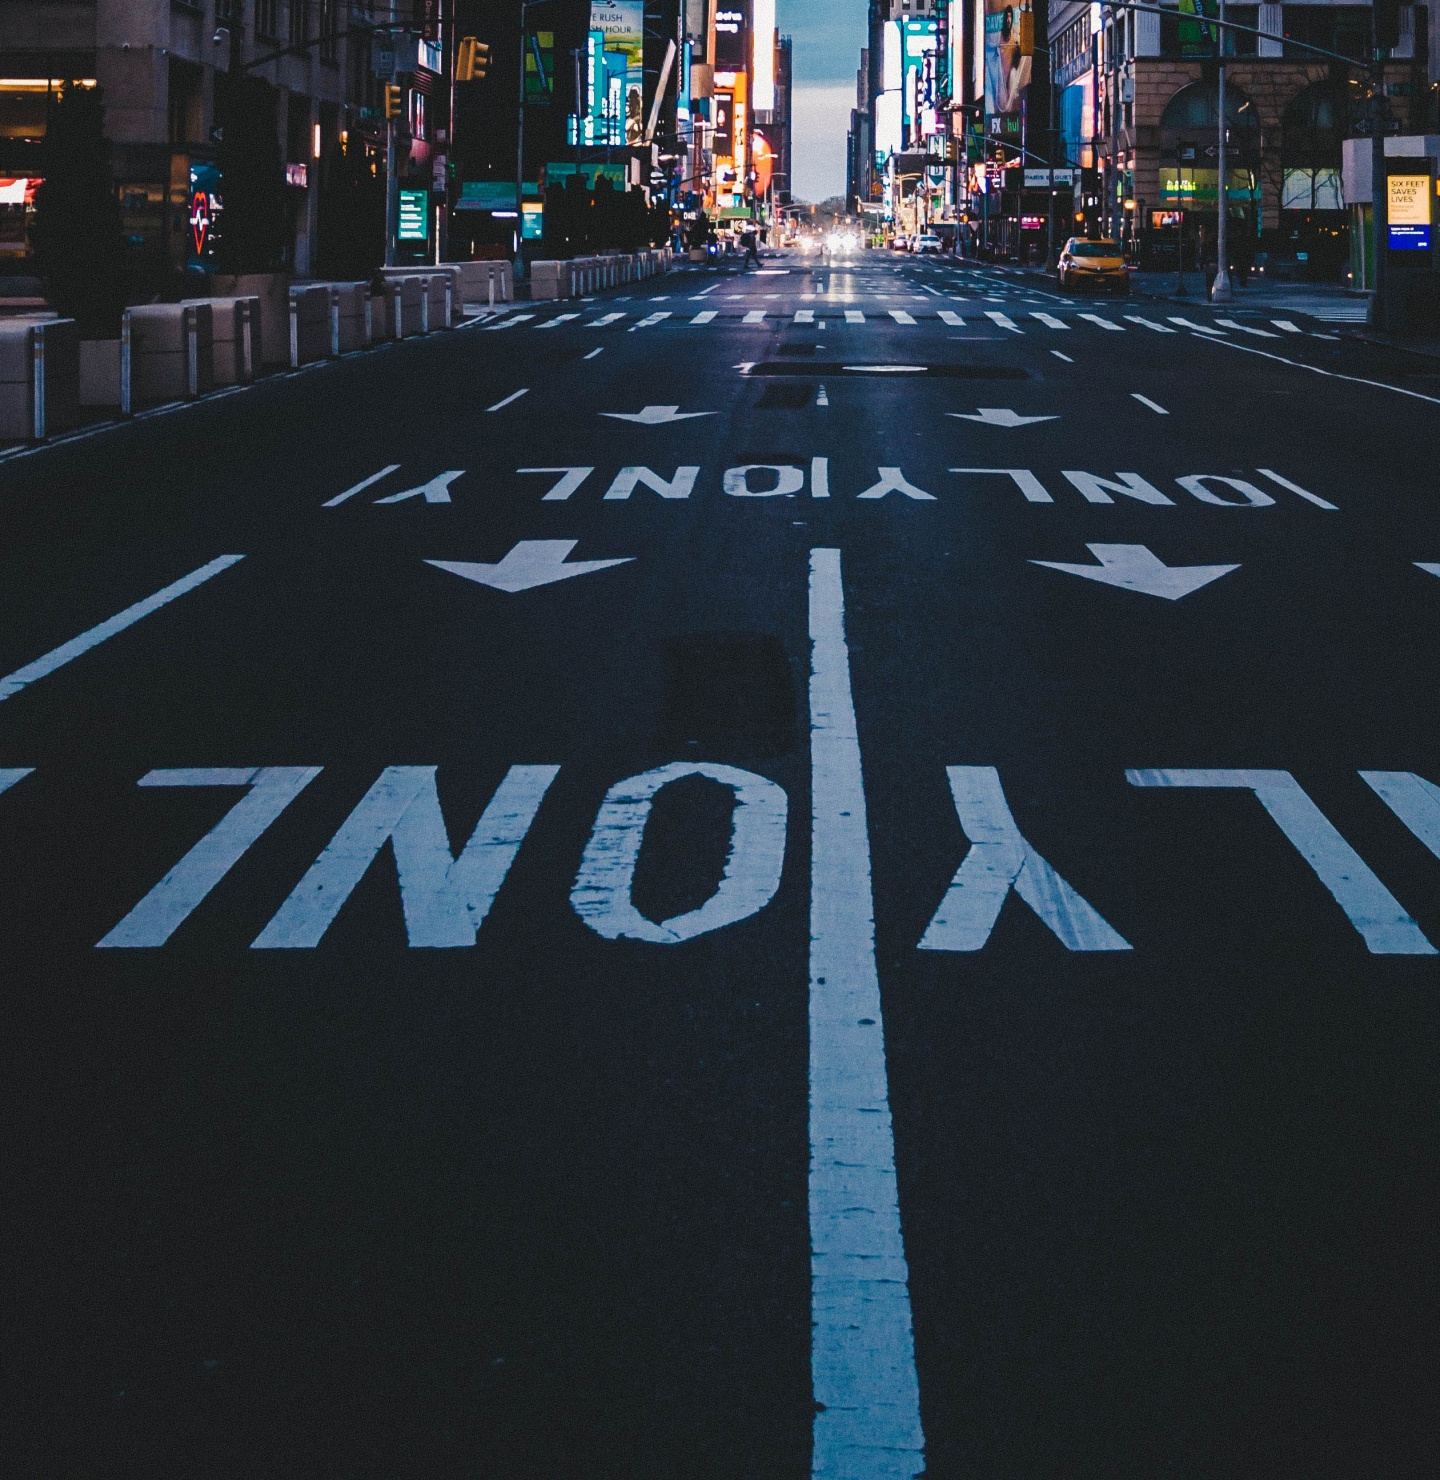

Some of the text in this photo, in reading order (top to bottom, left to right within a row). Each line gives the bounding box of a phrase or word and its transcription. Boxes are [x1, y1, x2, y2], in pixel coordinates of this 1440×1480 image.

[600, 13, 623, 22] RUSH
[605, 24, 632, 34] HOUR
[991, 118, 1002, 134] FX
[1007, 117, 1020, 133] hul
[1391, 180, 1425, 188] SIX FEET
[375, 464, 805, 504] ONLY
[857, 466, 1277, 508] ONLY
[0, 761, 789, 949] ONL
